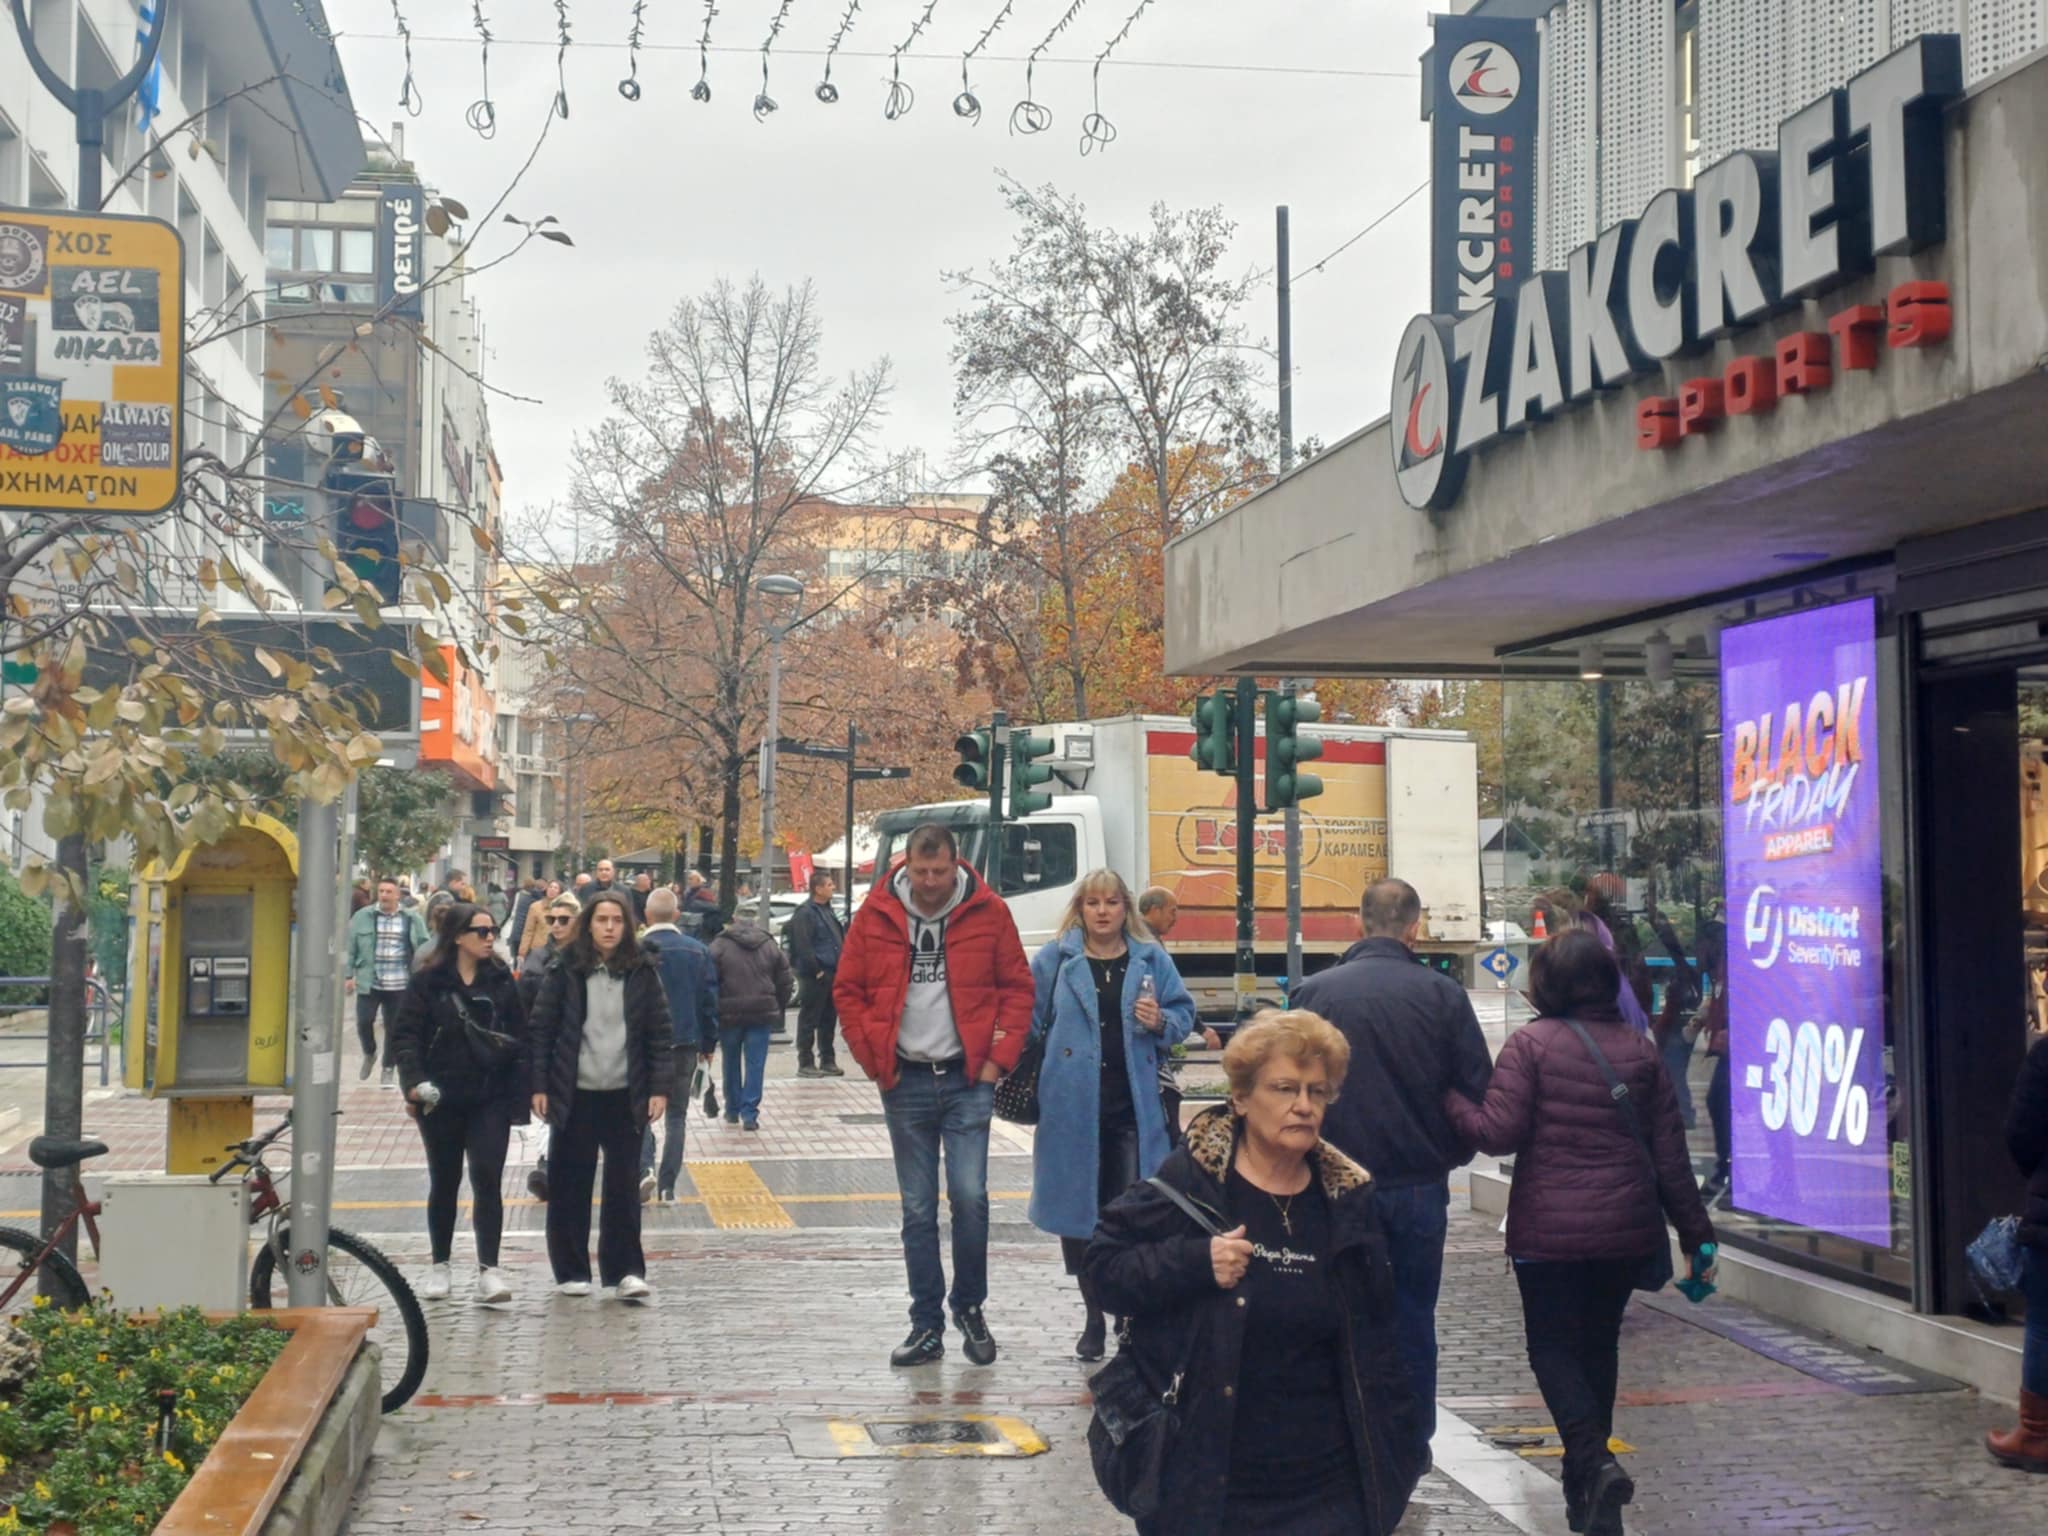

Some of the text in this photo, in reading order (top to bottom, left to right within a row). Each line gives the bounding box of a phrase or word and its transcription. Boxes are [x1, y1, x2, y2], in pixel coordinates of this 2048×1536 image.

[1458, 126, 1495, 311] KCRET
[1500, 136, 1514, 278] SPORTS
[49, 230, 113, 256] ΧΟΣ
[386, 198, 418, 294] ρετιρέ
[1453, 34, 1958, 456] ZAKCRET
[72, 270, 141, 294] AEL
[1636, 281, 1950, 450] SPORTS
[102, 406, 170, 427] ALWAYS
[137, 442, 170, 462] TOUR
[0, 471, 138, 496] ΧΗΜΑΤΩΝ
[1732, 676, 1868, 804] BLACK
[1745, 762, 1860, 832] FRIDAY
[1766, 829, 1834, 857] APPAREL
[1788, 905, 1860, 938] District
[1788, 941, 1861, 971] SeventyFive
[1746, 1017, 1869, 1147] -30%
